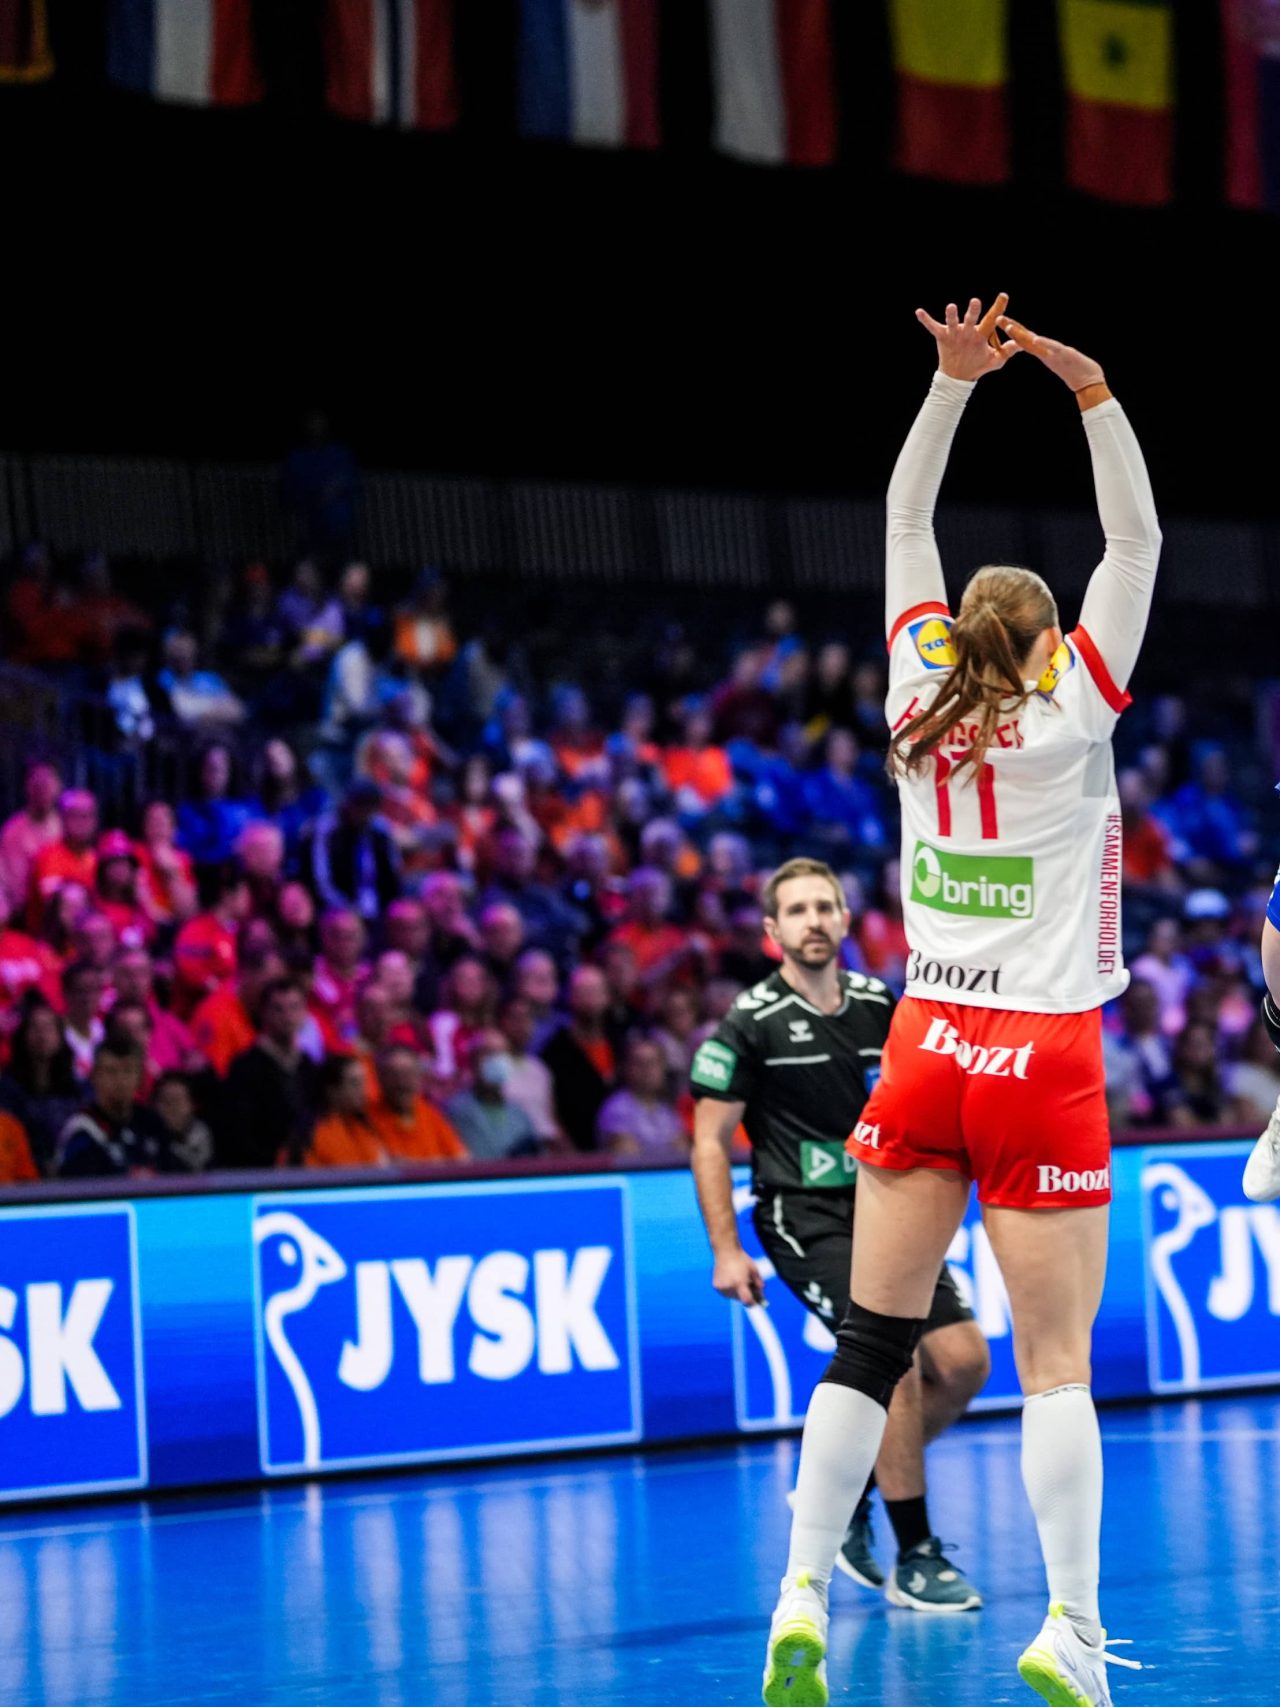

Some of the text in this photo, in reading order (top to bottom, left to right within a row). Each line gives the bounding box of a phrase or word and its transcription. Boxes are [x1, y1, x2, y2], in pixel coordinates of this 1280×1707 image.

[920, 747, 998, 839] 11
[943, 871, 1032, 918] bring
[1097, 814, 1122, 975] #SAMMENFORHOLDET
[907, 949, 1003, 995] Boozt
[918, 1017, 1035, 1080] Boozt
[337, 1246, 620, 1391] JYSK
